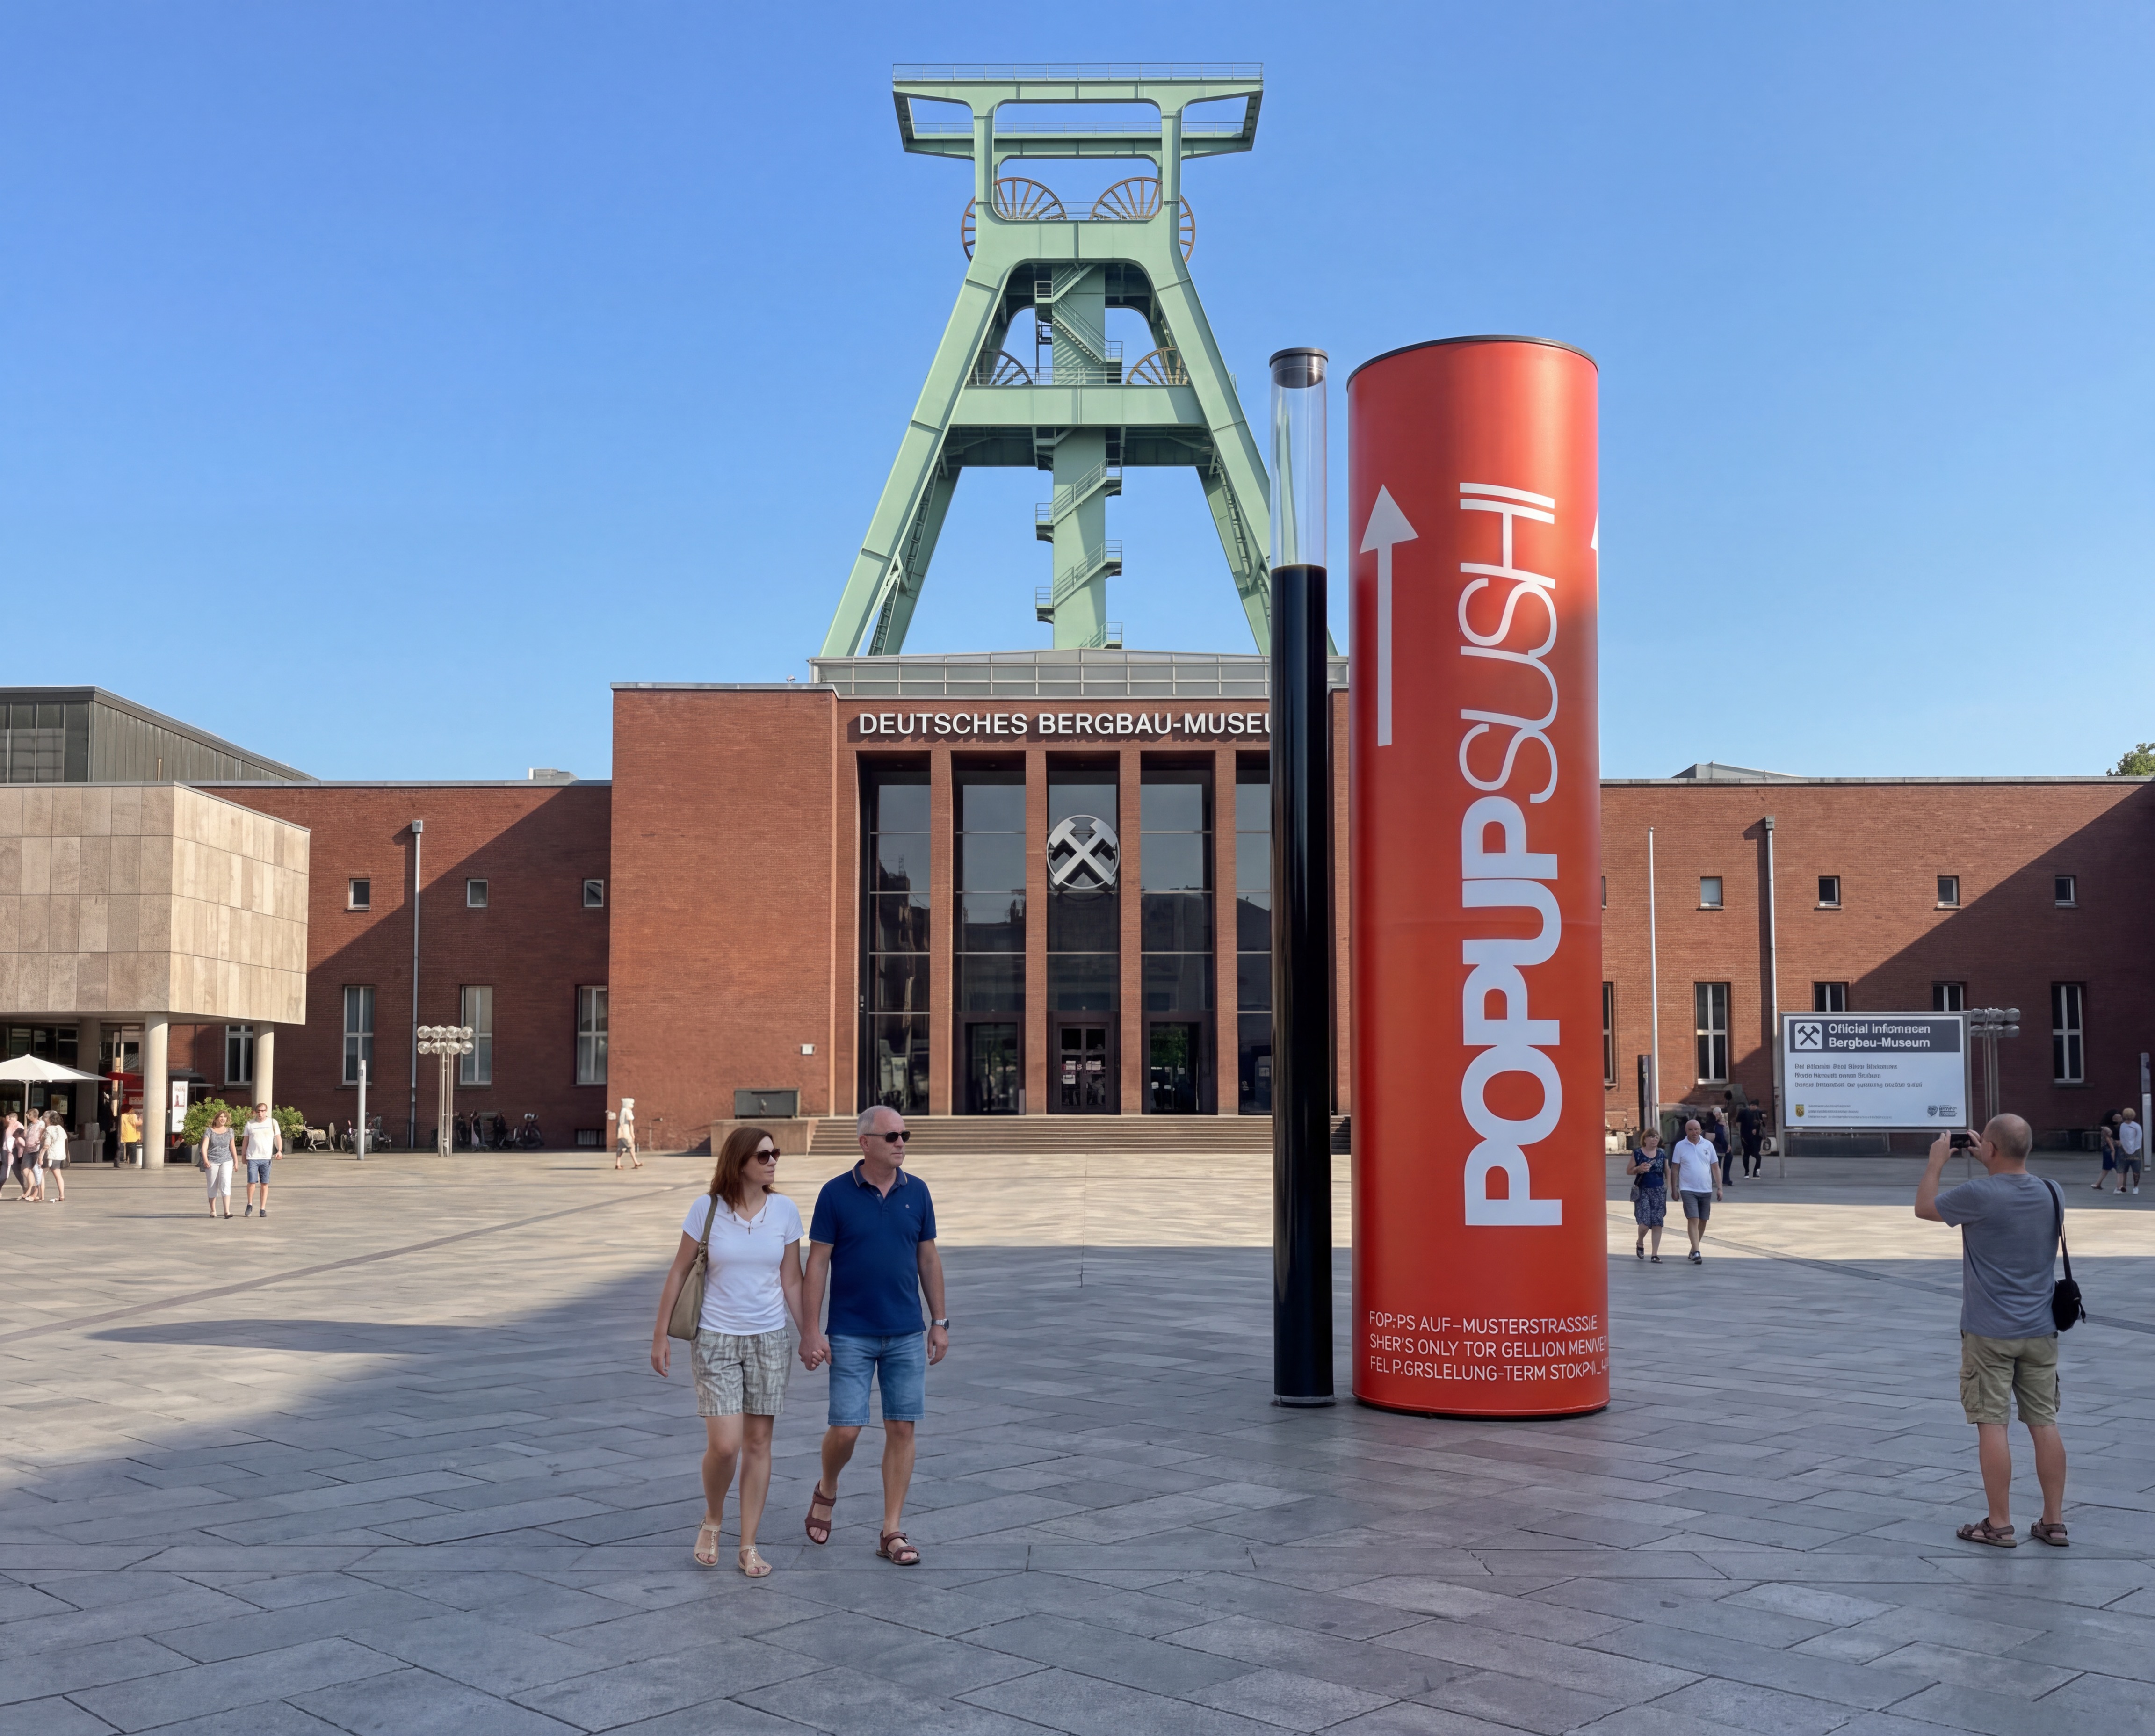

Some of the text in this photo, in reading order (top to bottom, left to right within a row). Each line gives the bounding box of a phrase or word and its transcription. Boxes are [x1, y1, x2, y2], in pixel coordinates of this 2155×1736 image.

[860, 713, 1027, 734] DEUTSCHES
[1418, 1339, 1459, 1356] ONLY
[1464, 1342, 1496, 1357] TOR
[1502, 1341, 1565, 1358] GELLION
[1370, 1356, 1389, 1373] FEL
